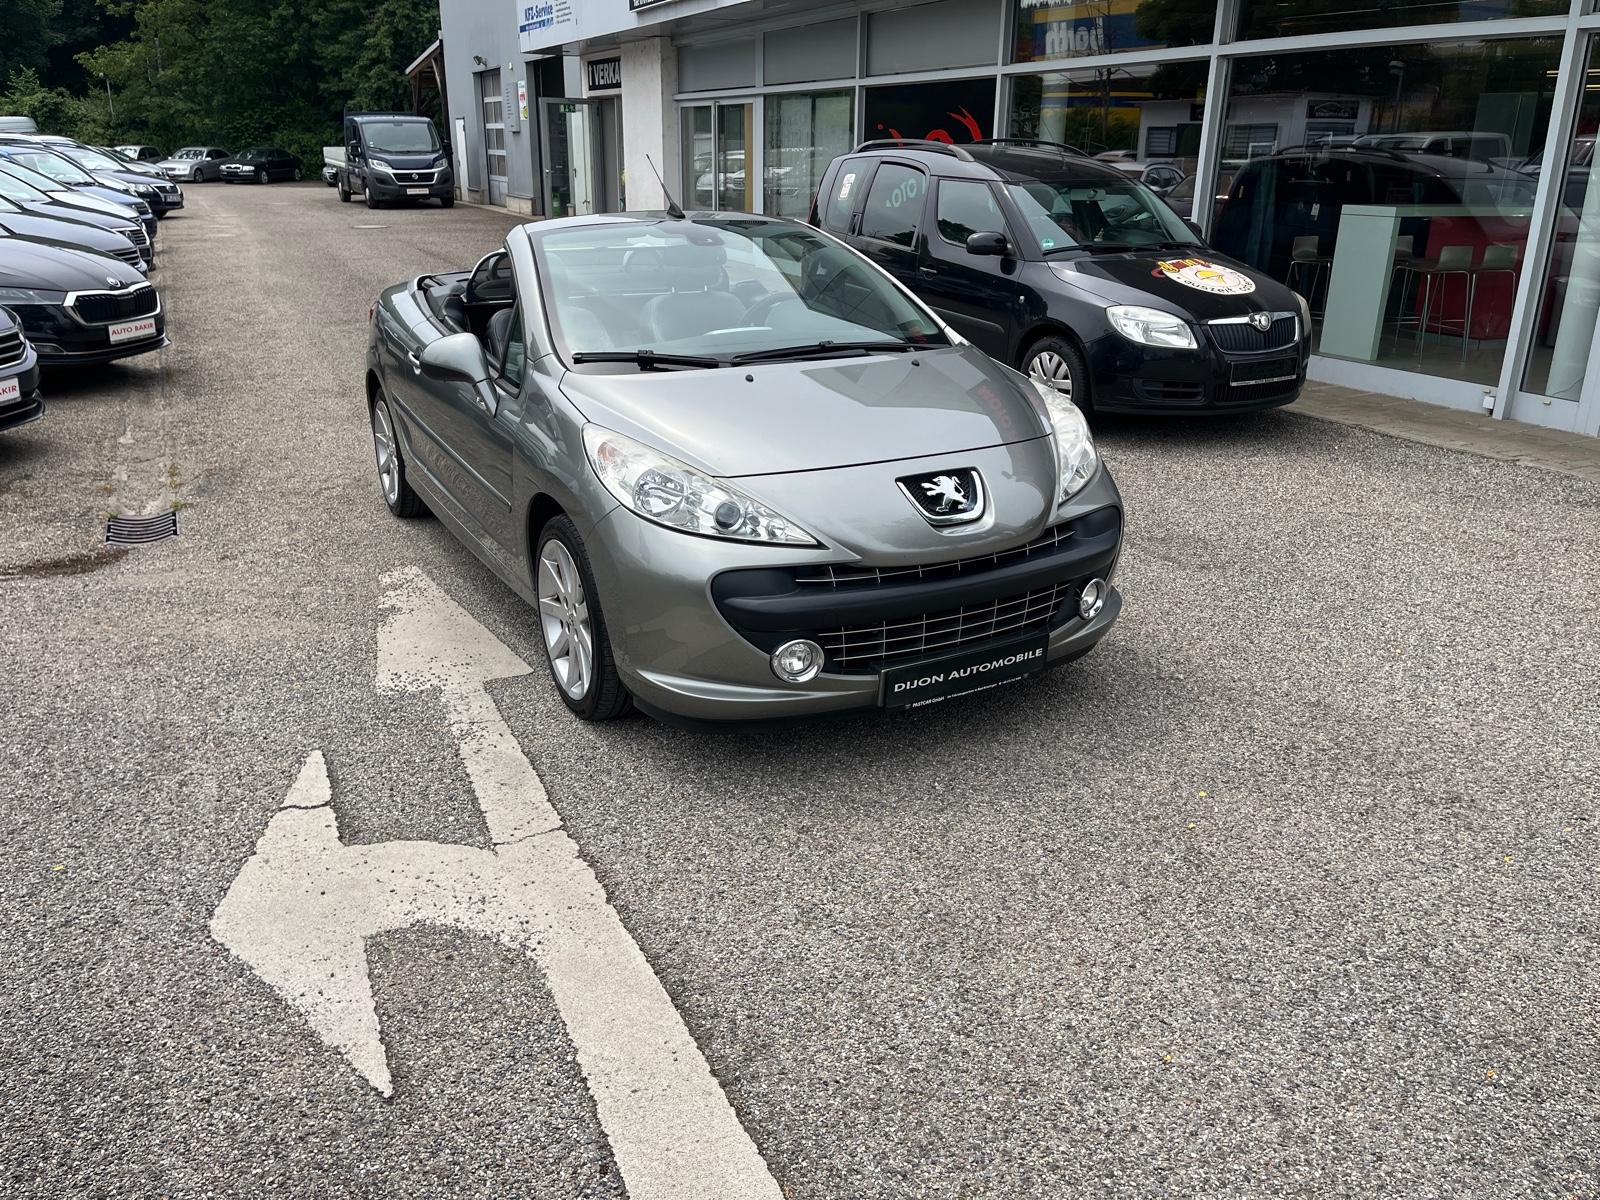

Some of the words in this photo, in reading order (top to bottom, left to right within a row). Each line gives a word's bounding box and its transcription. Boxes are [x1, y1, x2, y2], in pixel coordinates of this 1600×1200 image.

[524, 1, 553, 21] KFZ-Service
[111, 327, 132, 336] AUTO
[134, 322, 154, 332] BAKIR
[894, 673, 944, 692] DIJON
[948, 648, 1043, 680] AUTOMOBILE
